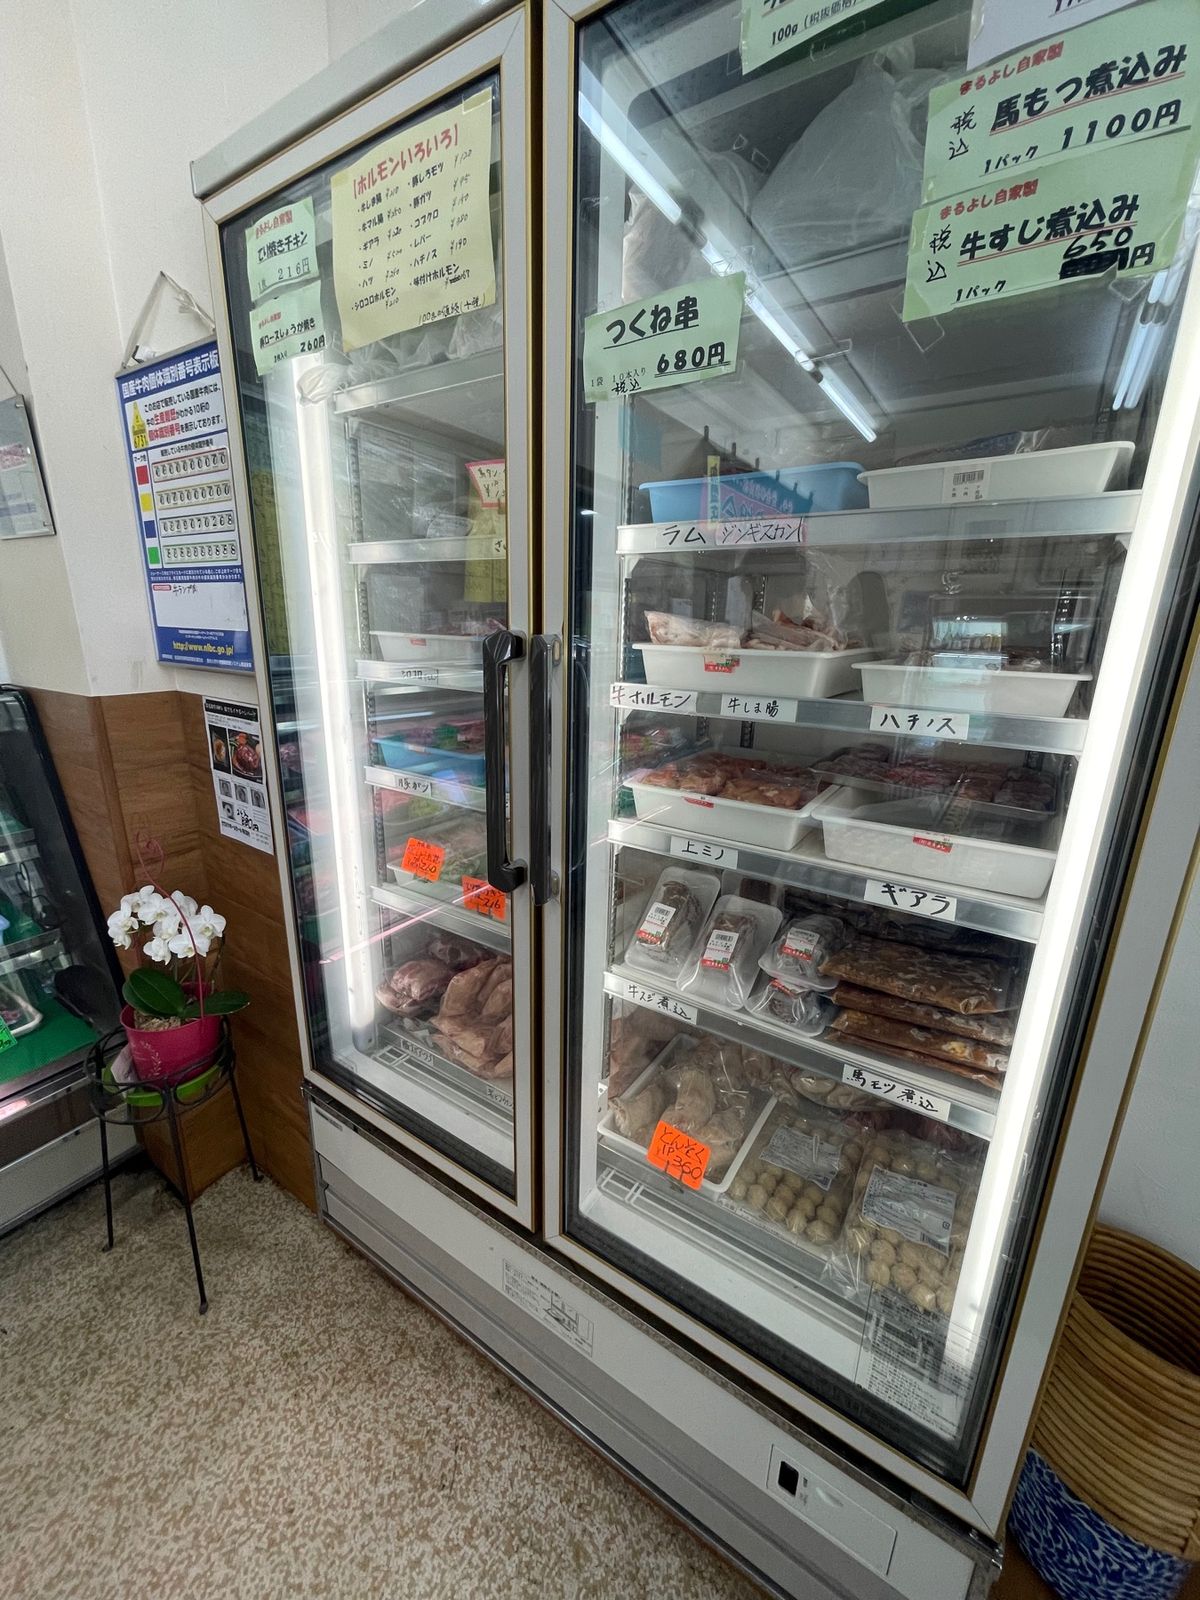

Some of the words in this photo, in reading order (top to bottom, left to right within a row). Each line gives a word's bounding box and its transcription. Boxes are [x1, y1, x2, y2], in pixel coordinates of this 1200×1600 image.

[960, 41, 1064, 96] まるよし自家製
[991, 44, 1187, 131] 馬もつ煮込み
[984, 145, 1038, 174] 1パック
[1062, 99, 1182, 150] 1100円
[940, 179, 1039, 220] まるよし自家製
[959, 194, 1139, 259] 牛すじ煮込み
[278, 257, 310, 280] 216円
[956, 280, 1006, 301] 1パック
[606, 296, 699, 344] つくね串
[300, 334, 325, 352] 260円
[657, 341, 725, 374] 680円
[662, 525, 706, 546] ラム
[722, 523, 798, 544] ジンギスカン
[612, 685, 691, 708] 牛ホルモン
[728, 698, 779, 718] 牛しま腸
[880, 713, 956, 734] ハチノス
[682, 841, 724, 860] 上ミノ
[881, 883, 950, 915] ギアラ
[628, 984, 691, 1020] 牛スジ煮込
[846, 1069, 938, 1112] 馬モツ煮込
